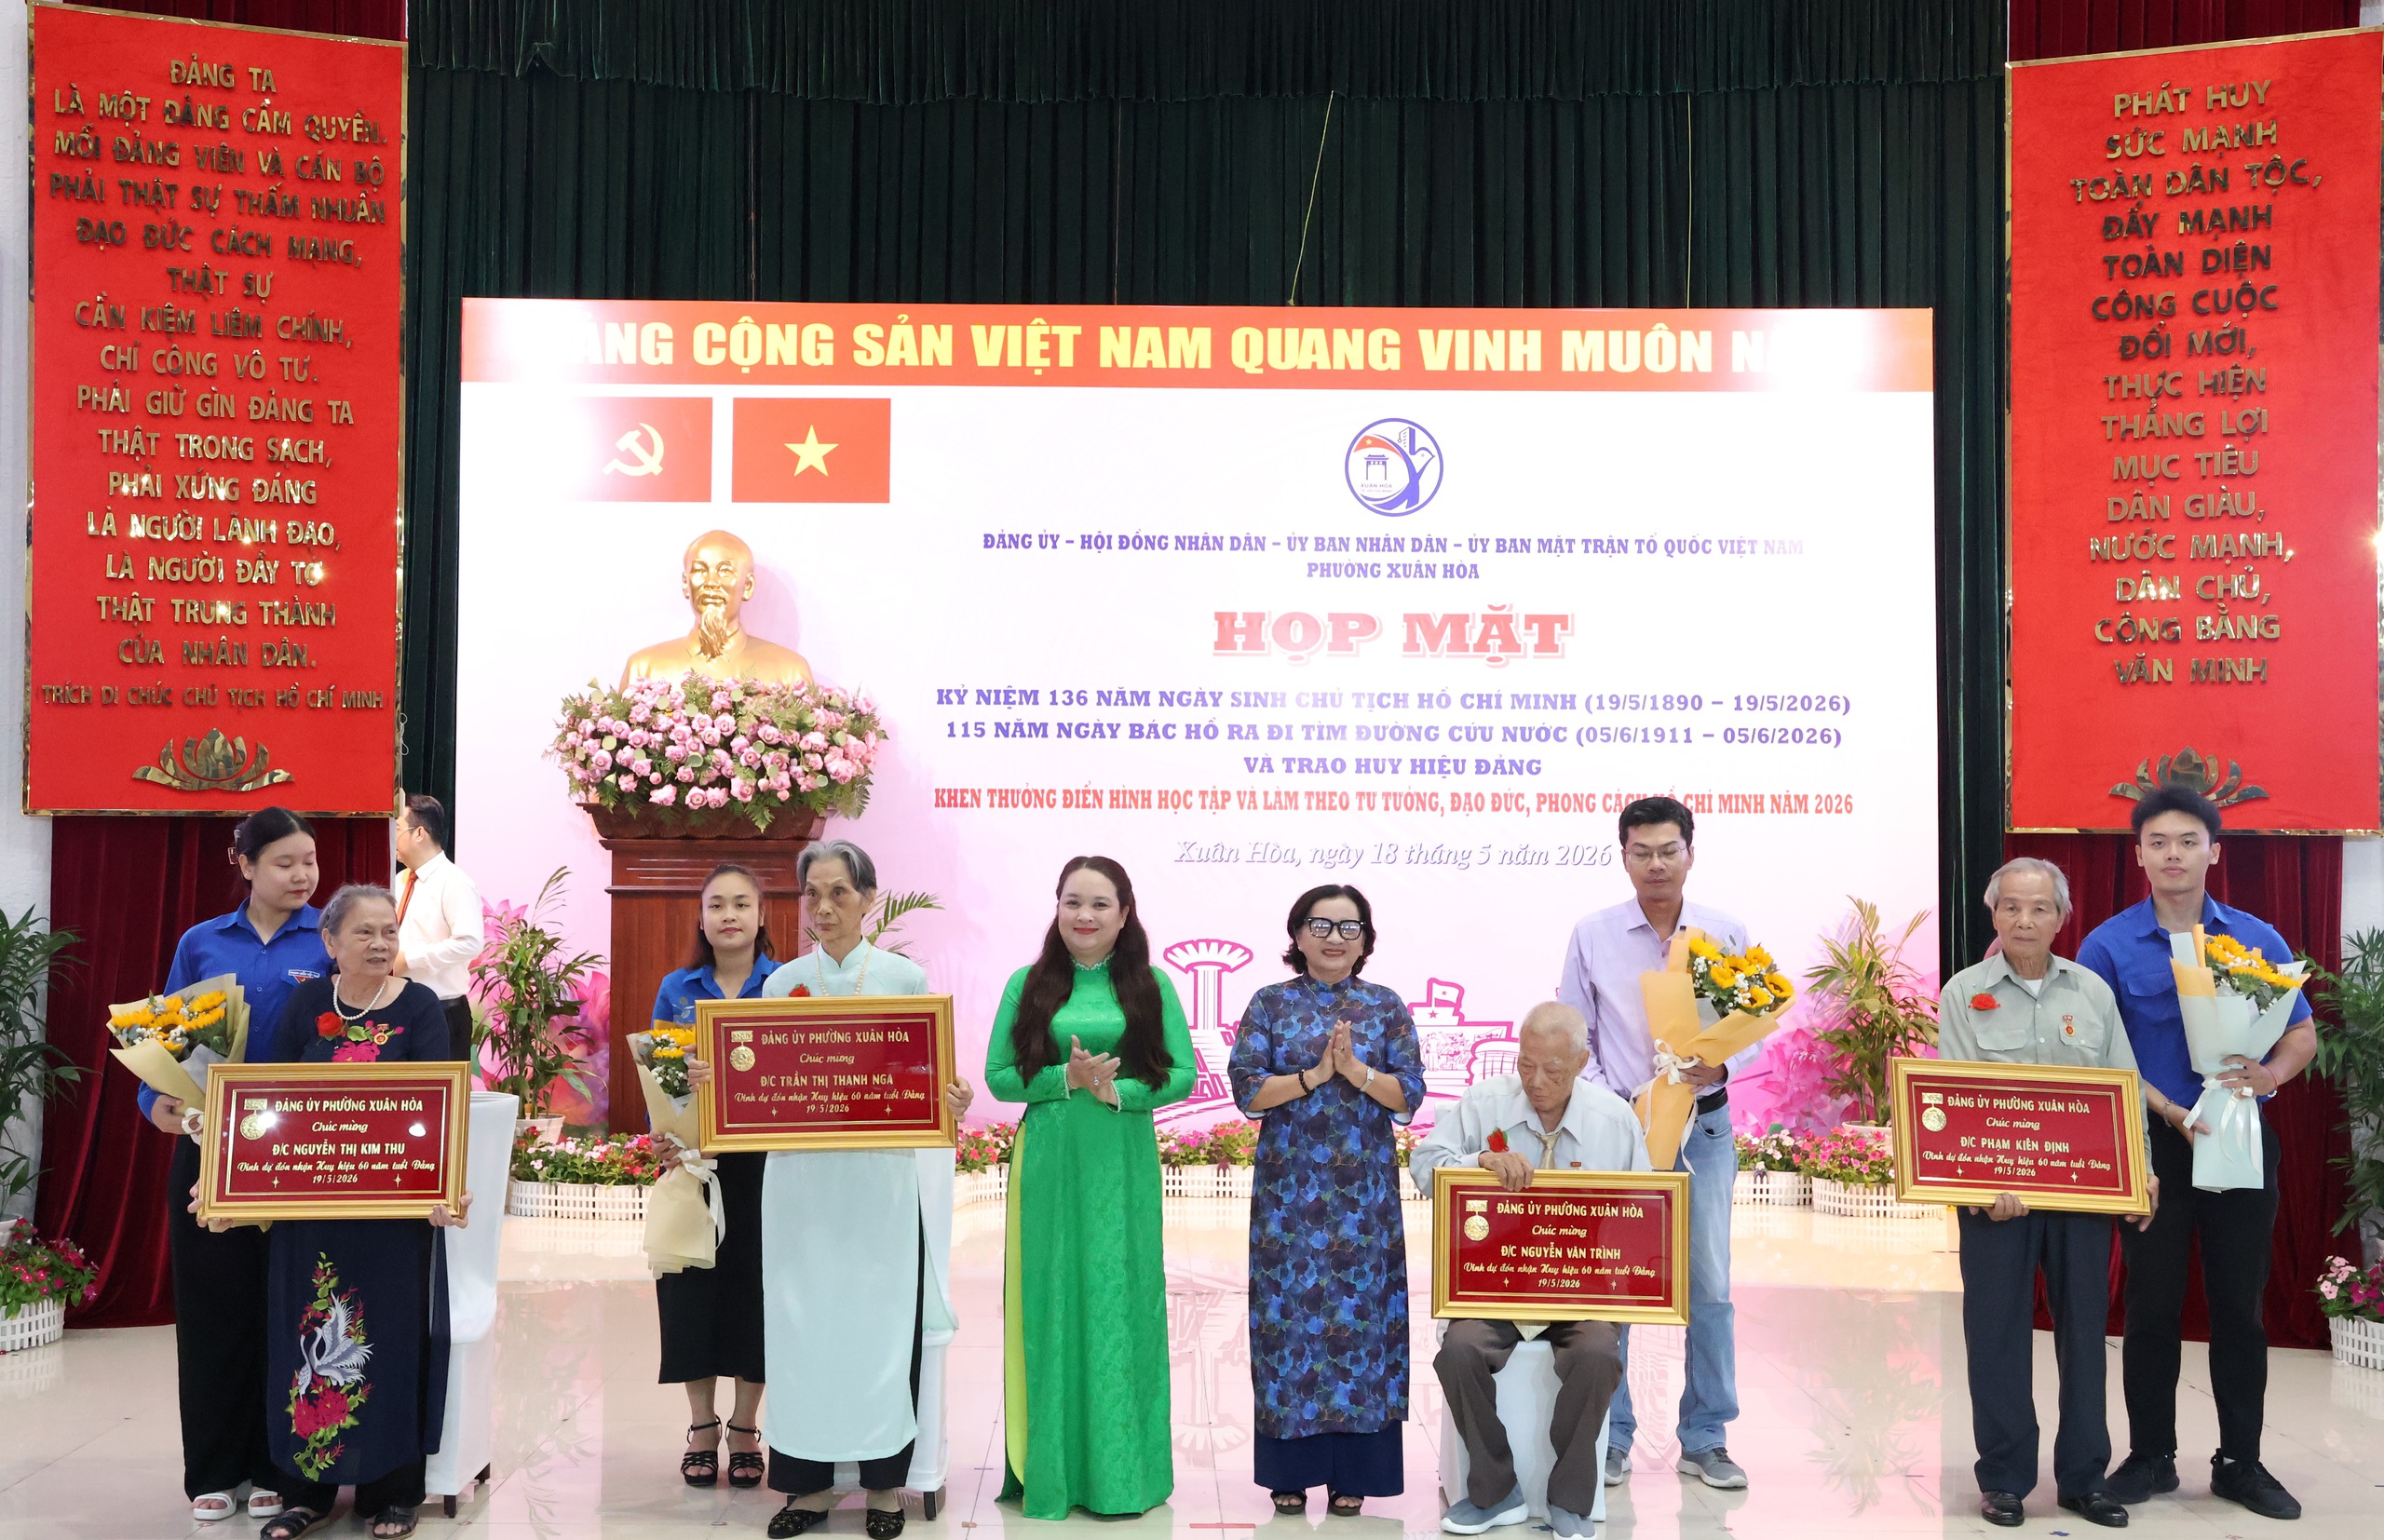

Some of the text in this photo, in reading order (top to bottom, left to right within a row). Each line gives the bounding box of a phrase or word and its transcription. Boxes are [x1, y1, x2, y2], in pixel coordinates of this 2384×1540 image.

[169, 52, 277, 92] ĐẢNG TA
[54, 82, 85, 115] LÀ
[99, 89, 151, 128] MỘT
[163, 93, 230, 129] ĐẢNG
[2114, 79, 2271, 117] PHÁT HUY
[2106, 120, 2277, 158] SỨC MẠNH
[76, 217, 362, 268] ĐẠO ĐỨC CÁCH MẠNG,
[2103, 239, 2271, 278] TOÀN DIỆN
[2093, 279, 2278, 318] CÔNG CUỘC
[564, 311, 673, 365] ẢNG
[693, 316, 834, 373] CỘNG
[853, 314, 953, 367] SẢN
[970, 317, 1082, 375] VIỆT
[1099, 326, 1212, 369] NAM
[1231, 326, 1401, 374] QUANG
[1418, 329, 1542, 371] VINH
[1561, 322, 1712, 372] MUÔN
[101, 340, 318, 383] CHÍ CÔNG VÔ TƯ.
[77, 379, 130, 412] PHẢI
[196, 386, 236, 418] GÌN
[248, 387, 313, 423] ĐẢNG
[328, 400, 354, 425] TA
[2113, 444, 2259, 487] MỤC TIÊU
[2107, 485, 2265, 521] DÂN GIÀU,
[982, 528, 1804, 560] ĐẢNG ỦY HỘI ĐỒNG NHÂN DÂN ỦY BAN NHÂN DÂN ỦY BAN MẶT TRẬN TỔ QUỐC VIỆT NAM
[2091, 528, 2294, 565] NƯỚC MẠNH,
[1307, 559, 1480, 580] PHƯỜNG XUÂN HÒA
[97, 591, 336, 627] THẬT TRUNG THÀNH
[118, 630, 317, 668] CỦA NHÂN DÂN.
[1213, 603, 1574, 669] HỌP MẶT
[2114, 653, 2267, 683] VĂN MINH
[936, 683, 1851, 717] KỶ NIỆM 136 NĂM NGÀY SINH CHỦ TỊCH HỒ CHÍ MINH (19/5/1890 19/5/2026)
[946, 716, 1842, 750] 115 NĂM NGÀY BÁC HỒ RA ĐI TÌM ĐƯỜNG CỨU NƯỚC (05/6/1911 05/6/2026)
[1242, 752, 1542, 779] VÀ TRAO HUY HIỆU ĐẢNG
[1173, 841, 1613, 871] Xuân Hòa, ngày 18 tháng 5 năm 2026
[761, 1030, 789, 1046] ĐẢNG
[792, 1029, 806, 1045] ỦY
[808, 1028, 851, 1045] PHƯỜNG
[855, 1028, 884, 1043] XUÂN
[887, 1027, 910, 1043] HÒA
[760, 1071, 894, 1088] Đ/C TRẦN THỊ THANH NGA
[275, 1097, 304, 1112] ĐẢNG
[306, 1097, 320, 1112] ỦY
[322, 1095, 366, 1112] PHƯỜNG
[369, 1097, 398, 1112] XUÂN
[400, 1097, 423, 1112] HÒA
[1947, 1094, 1974, 1108] ĐẢNG
[1977, 1094, 1990, 1109] ỦY
[1993, 1097, 2035, 1112] PHƯỜNG
[2038, 1100, 2066, 1113] XUÂN
[2068, 1101, 2090, 1114] HÒA
[272, 1139, 405, 1157] Đ/C NGUYỄN THỊ KIM THU
[1960, 1136, 2069, 1155] Đ/C PHẠM KIÊN ĐỊNH
[312, 1173, 358, 1184] 19/5/2026
[1994, 1166, 2037, 1177] 19/5/2026
[1497, 1199, 1524, 1214] ĐẢNG
[1527, 1199, 1541, 1216] ỦY
[1544, 1202, 1587, 1218] PHƯỜNG
[1591, 1204, 1619, 1218] XUÂN
[1622, 1205, 1644, 1219] HÒA
[1501, 1241, 1620, 1259] Đ/C NGUYỄN VĂN TRÌNH
[1537, 1277, 1580, 1289] 19/5/2026
